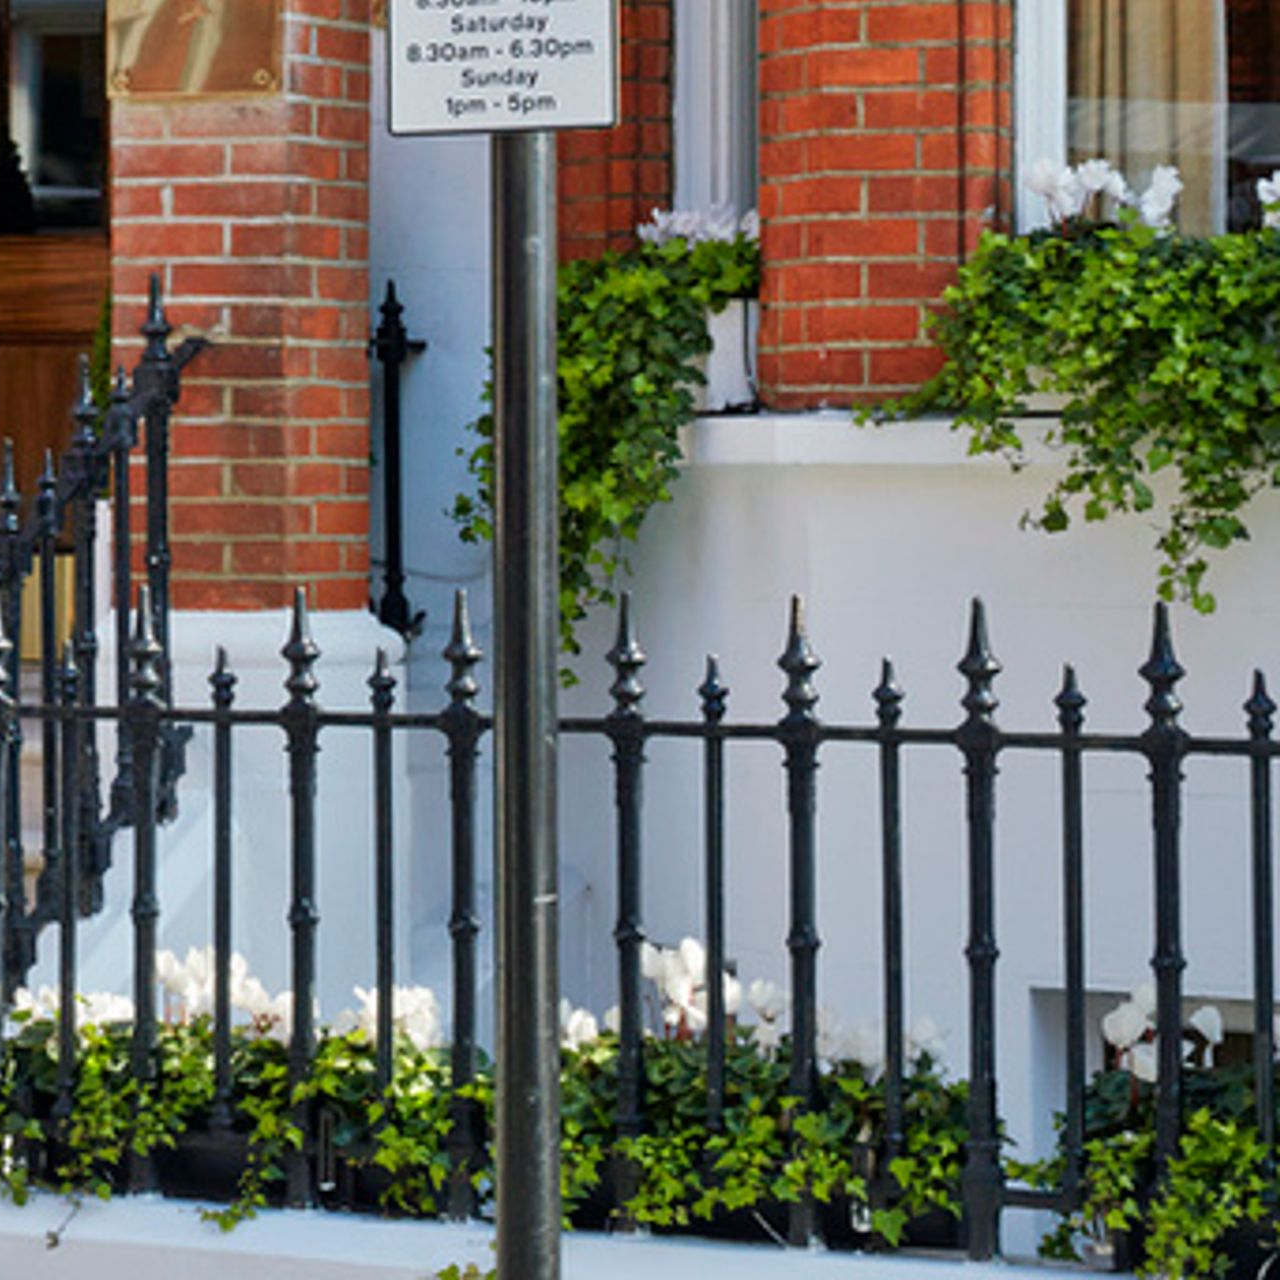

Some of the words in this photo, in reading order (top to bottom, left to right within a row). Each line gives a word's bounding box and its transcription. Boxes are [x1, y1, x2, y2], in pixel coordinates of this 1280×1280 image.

[451, 11, 548, 34] Saturday
[406, 44, 490, 64] 8.30am
[509, 38, 594, 59] 6.30pm
[461, 67, 539, 89] Sunday
[446, 96, 487, 117] 1pm
[508, 93, 557, 114] 5pm
